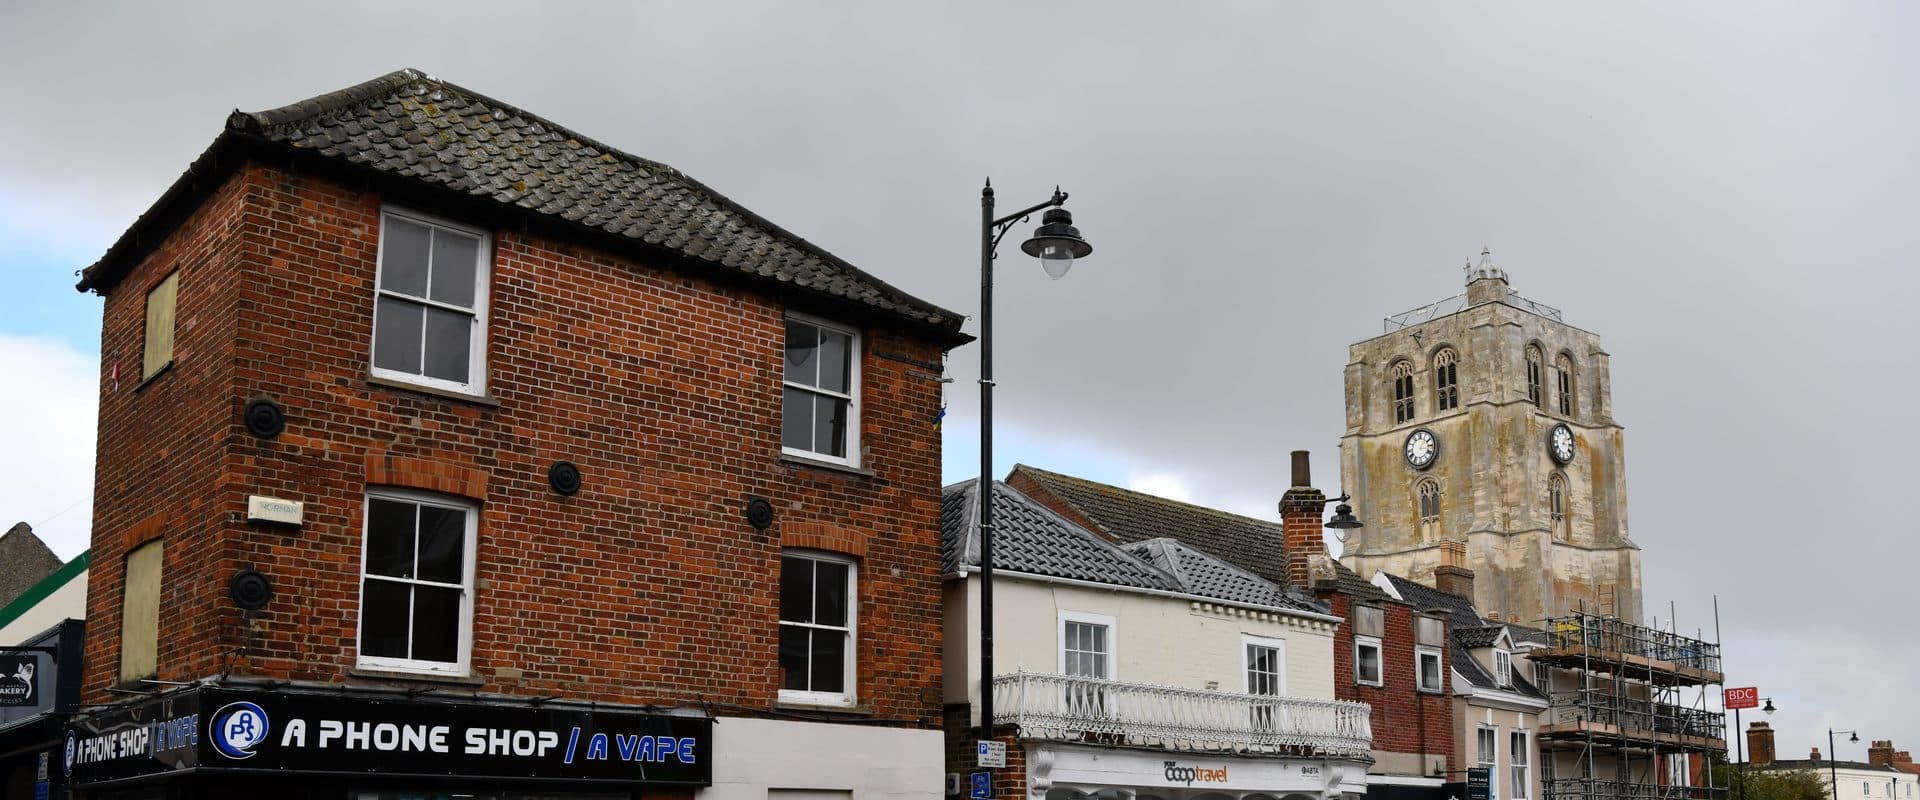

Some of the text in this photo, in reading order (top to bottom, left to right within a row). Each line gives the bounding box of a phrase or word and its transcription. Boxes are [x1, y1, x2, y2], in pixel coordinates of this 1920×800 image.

[1729, 689, 1754, 700] BDC
[77, 740, 84, 764] A
[84, 733, 118, 763] PHONE
[119, 726, 149, 758] SHOP
[167, 713, 199, 750] VAPE
[280, 718, 306, 747] A
[318, 719, 450, 753] PHONE
[464, 727, 559, 757] SHOP
[586, 732, 609, 760] A
[615, 734, 696, 764] VAPE
